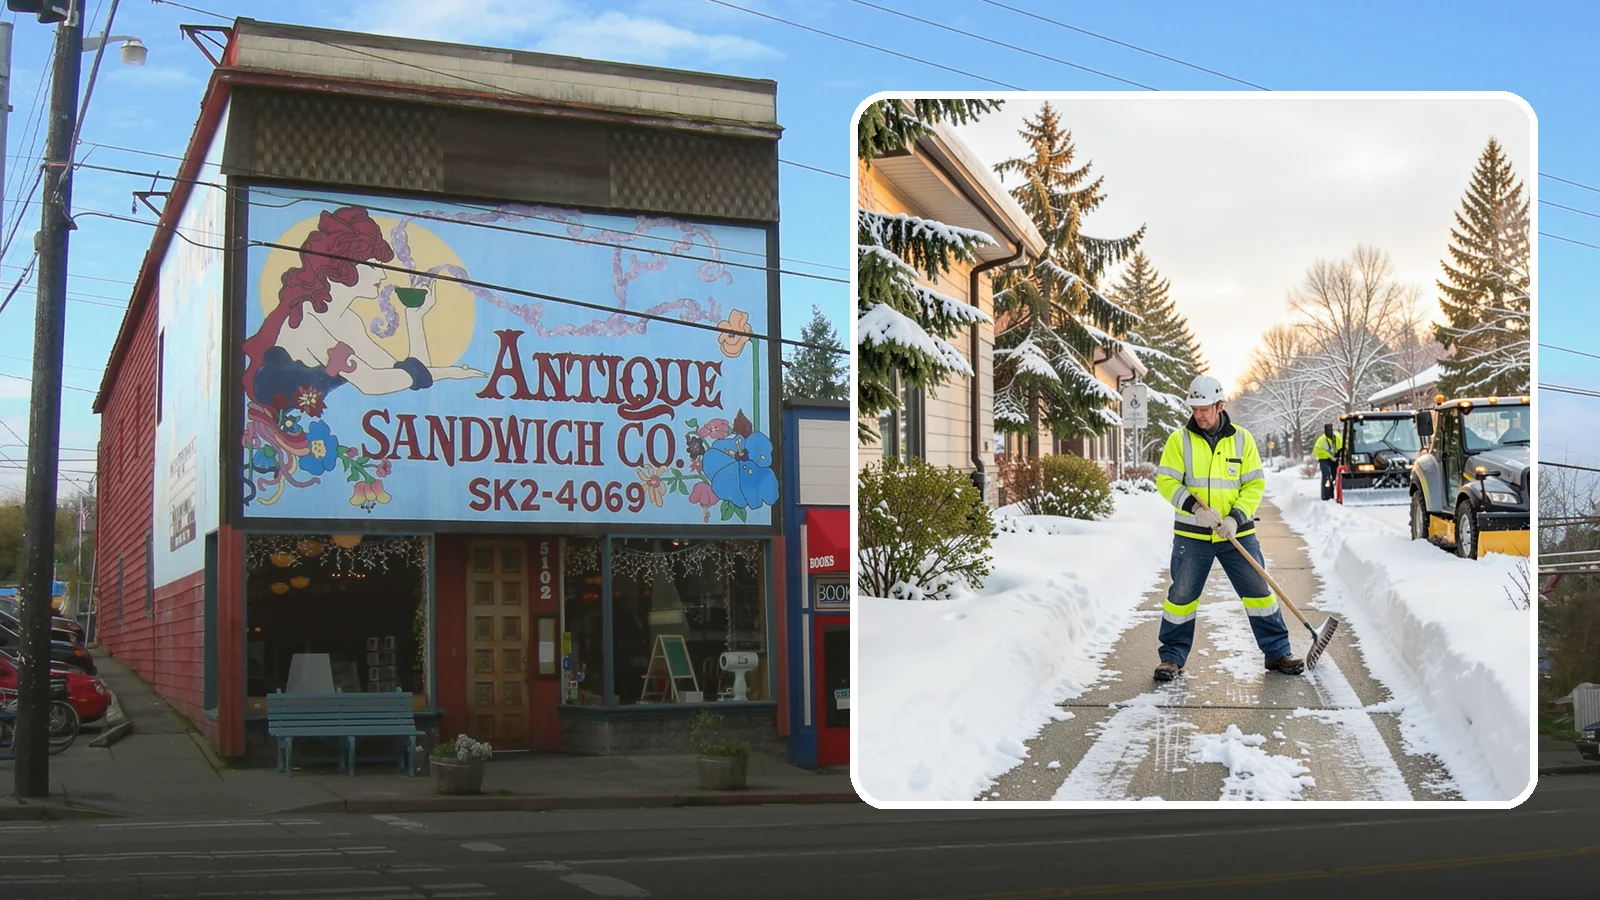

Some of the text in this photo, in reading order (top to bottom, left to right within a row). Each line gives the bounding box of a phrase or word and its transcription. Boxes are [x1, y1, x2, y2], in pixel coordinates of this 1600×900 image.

[476, 328, 723, 421] ANTIQUE
[361, 408, 685, 469] SANDWICH CO.
[468, 476, 646, 513] SK2-4069
[539, 541, 551, 600] 5102
[809, 555, 835, 569] BOOKS
